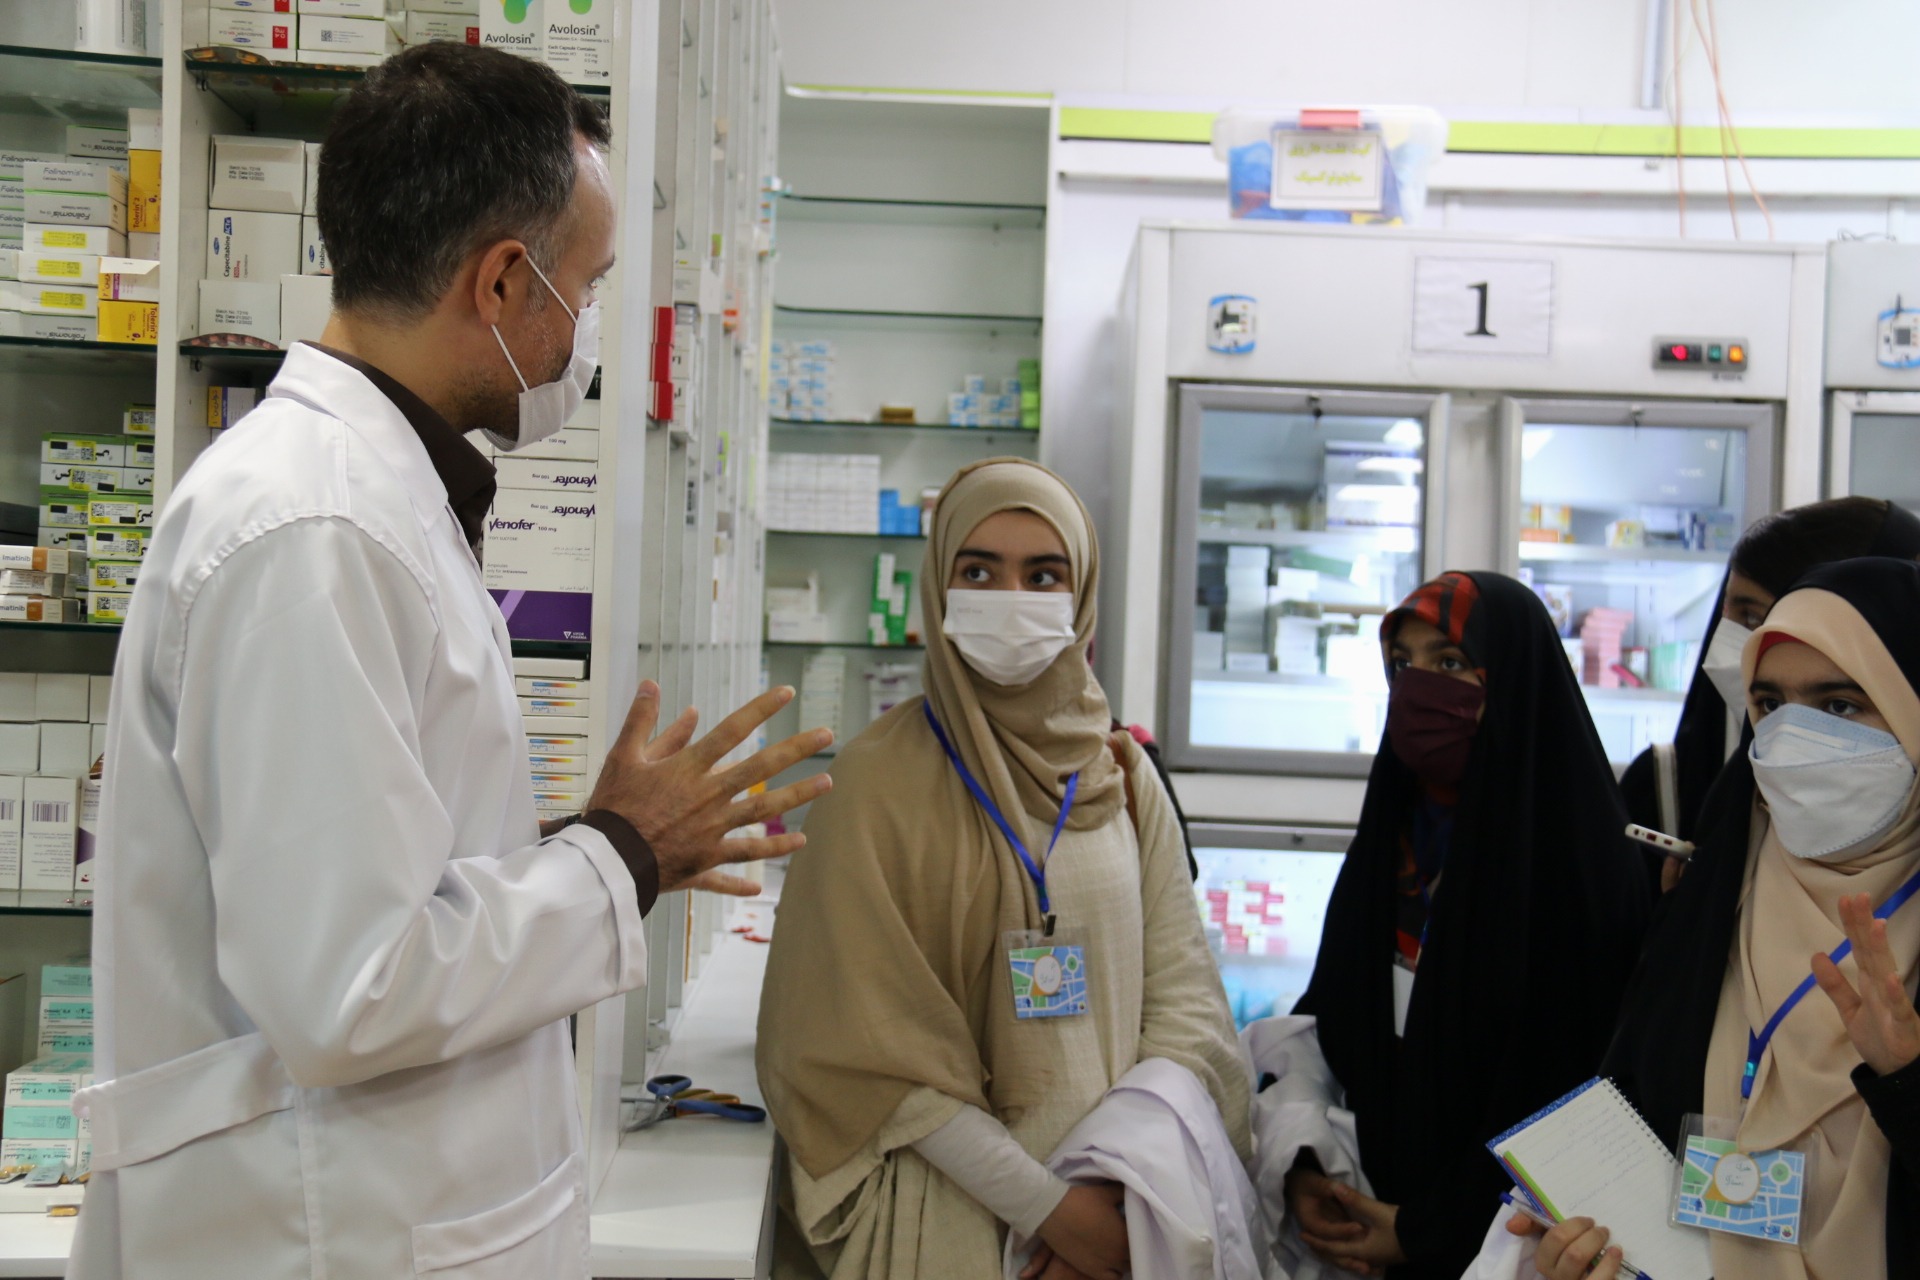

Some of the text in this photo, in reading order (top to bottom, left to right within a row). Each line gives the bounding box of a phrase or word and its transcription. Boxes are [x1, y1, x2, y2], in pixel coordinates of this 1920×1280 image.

[0, 185, 24, 193] Folino
[1465, 280, 1498, 337] 1
[553, 474, 597, 487] Venofer
[552, 504, 595, 517] Venofer
[489, 518, 535, 532] Venofer
